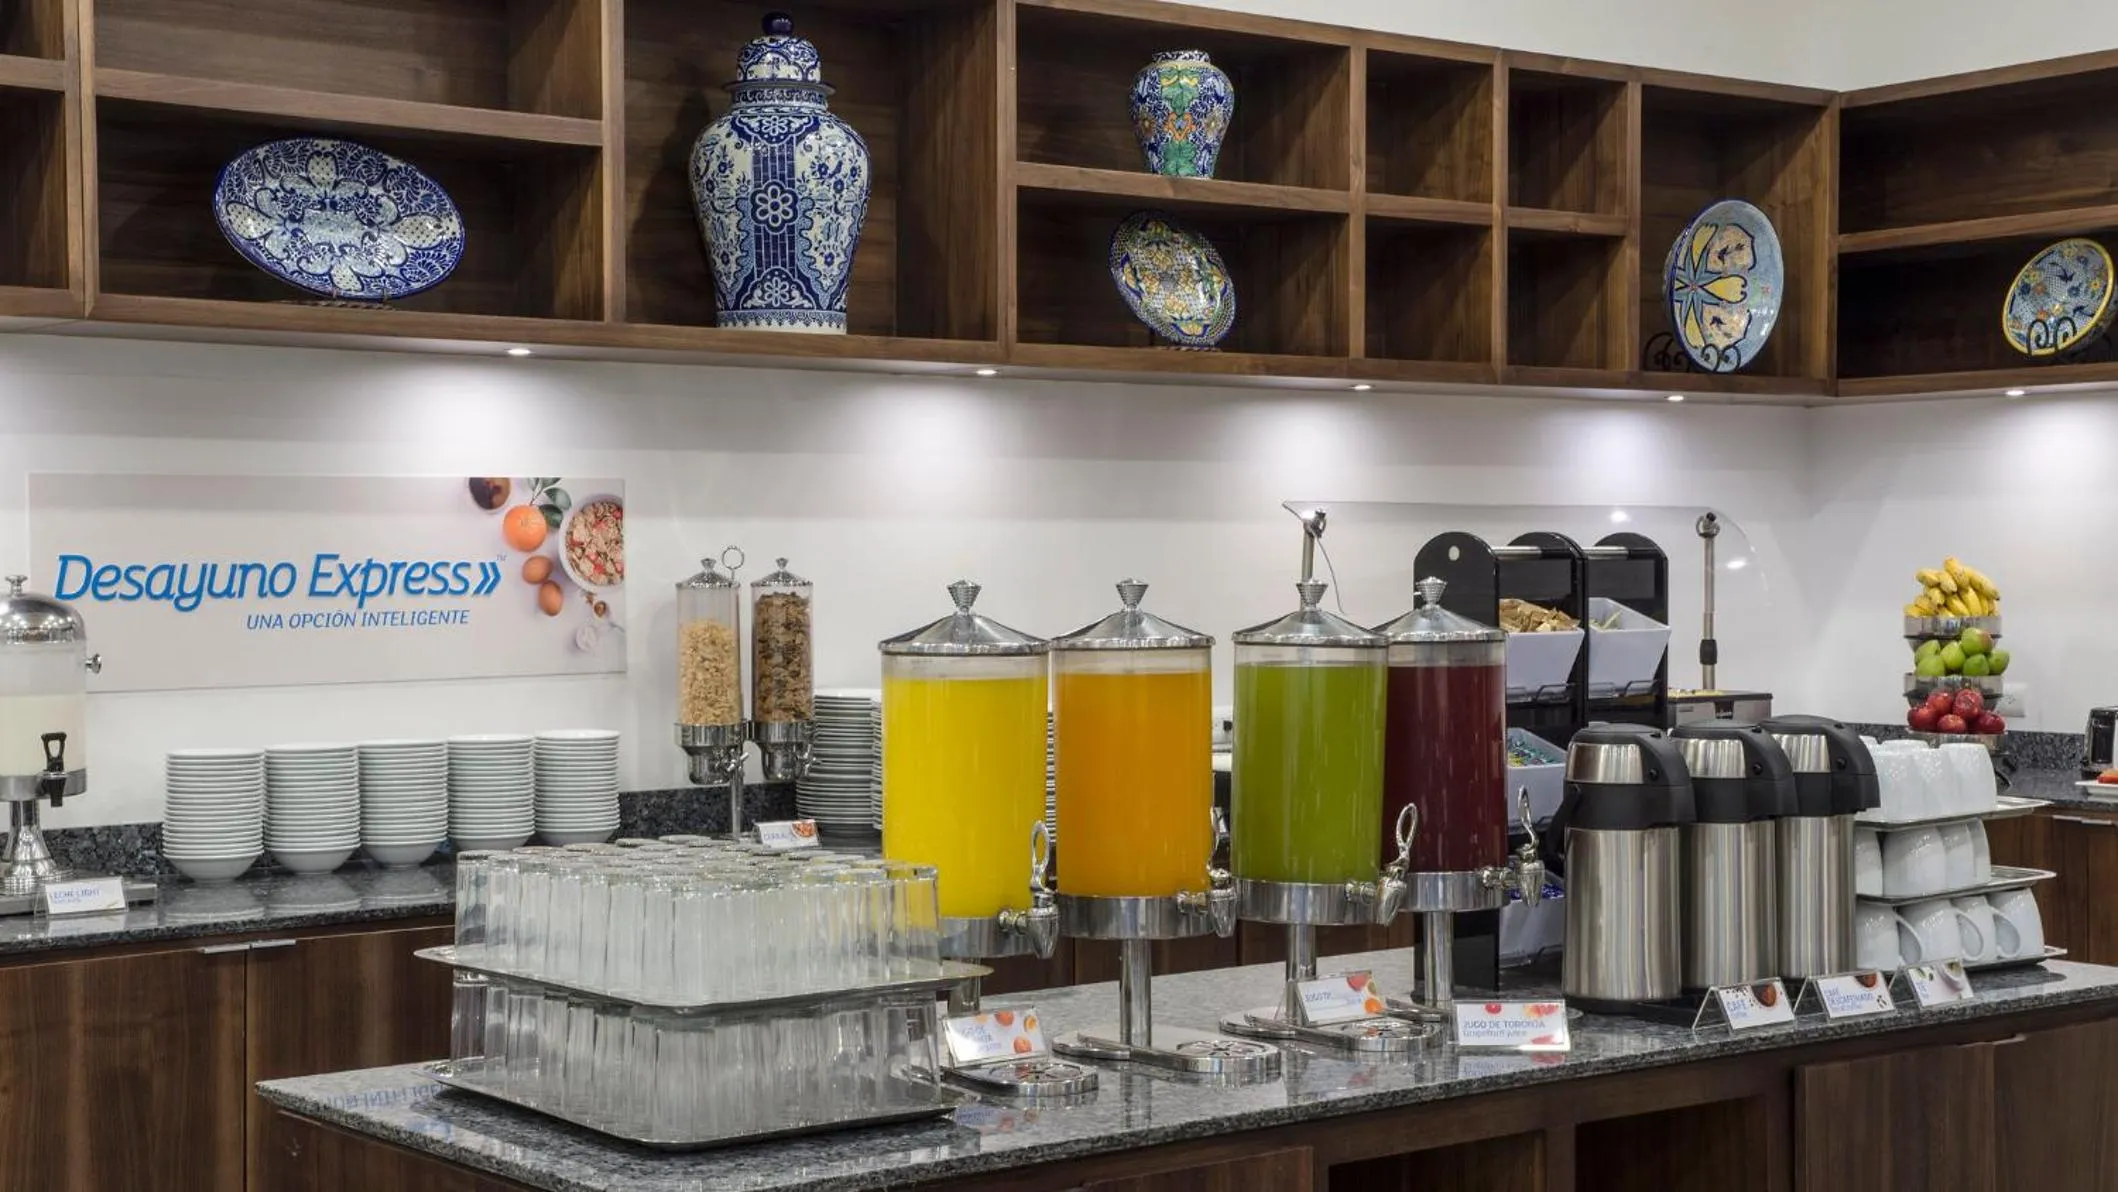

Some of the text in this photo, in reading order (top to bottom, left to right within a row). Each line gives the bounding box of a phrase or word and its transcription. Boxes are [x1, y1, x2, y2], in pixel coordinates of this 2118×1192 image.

[55, 554, 297, 612] Desayuno
[247, 609, 470, 630] UNA OPCIÓN INTELIGENTE
[1463, 1020, 1487, 1029] JUGO
[1489, 1020, 1501, 1029] DE
